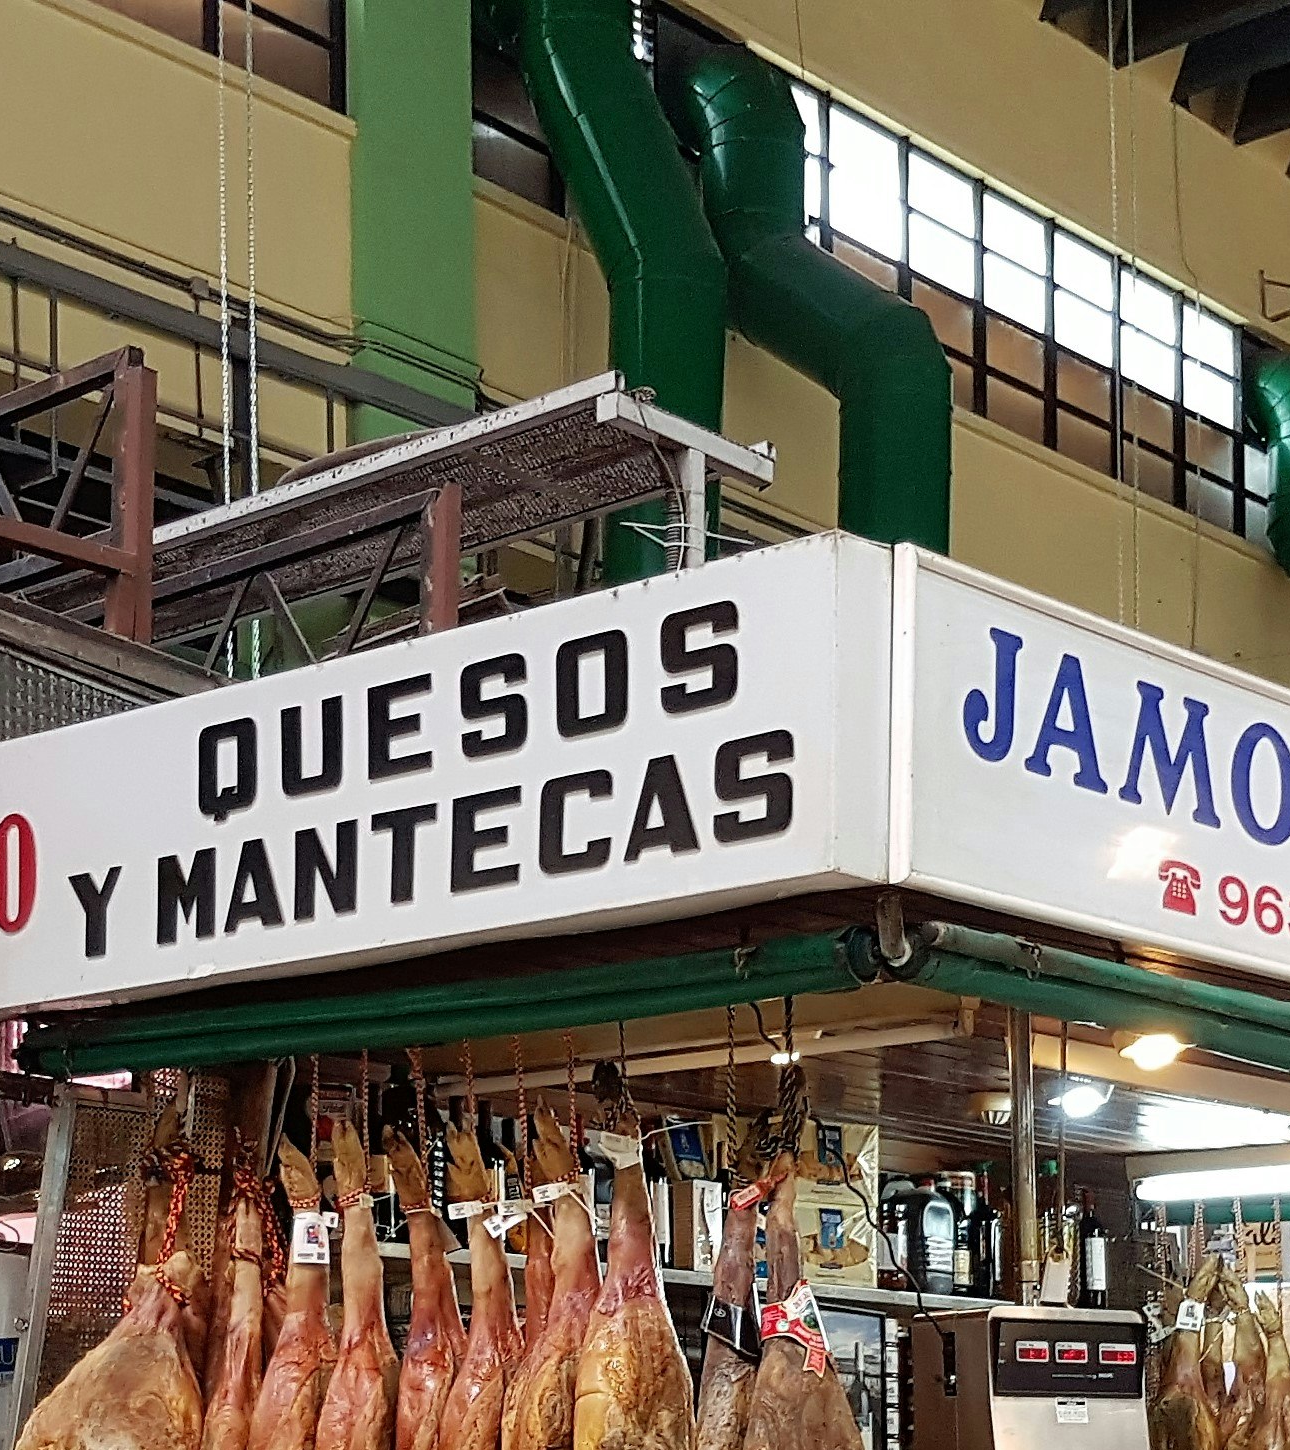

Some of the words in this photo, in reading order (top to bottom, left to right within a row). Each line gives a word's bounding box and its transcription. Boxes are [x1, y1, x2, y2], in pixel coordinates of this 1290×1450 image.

[197, 600, 741, 823] QUESOS
[67, 864, 123, 960] Y
[155, 728, 796, 946] MANTECAS
